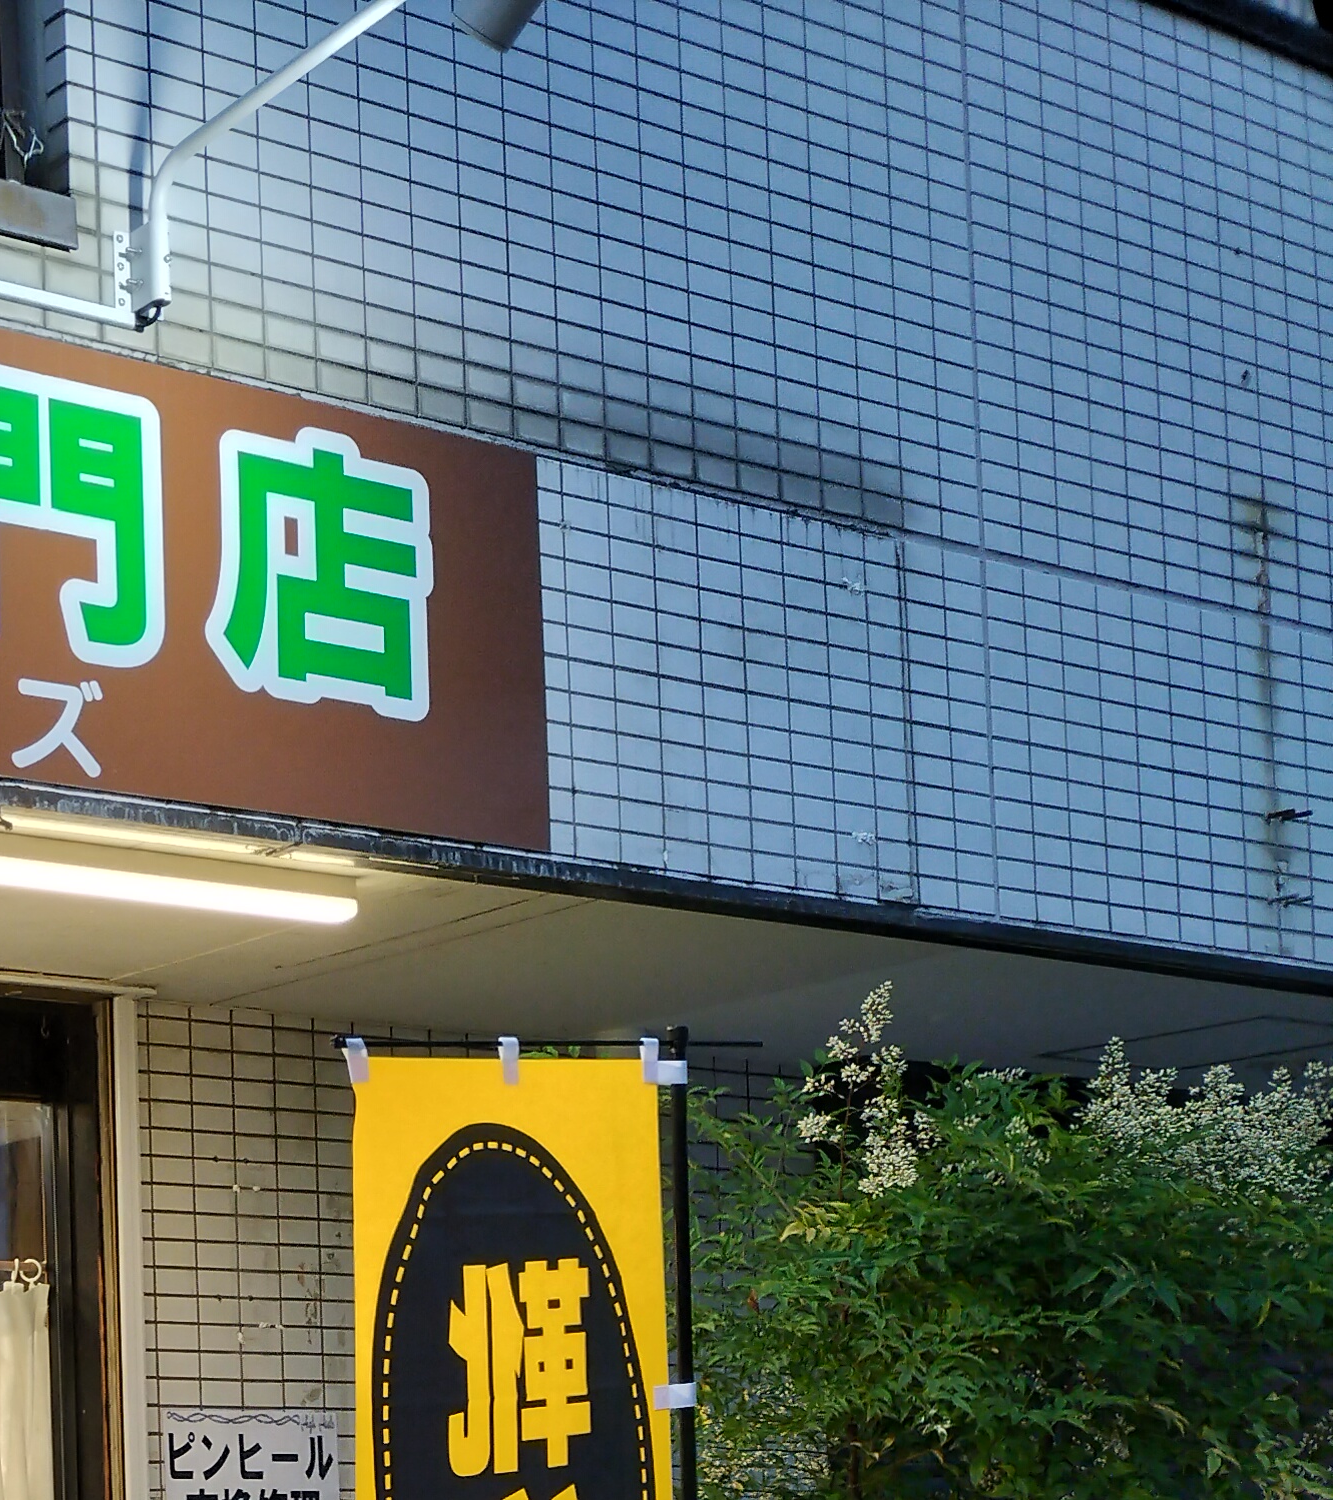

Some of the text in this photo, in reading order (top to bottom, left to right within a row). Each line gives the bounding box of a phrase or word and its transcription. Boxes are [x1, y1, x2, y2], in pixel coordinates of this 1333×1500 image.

[167, 1431, 333, 1481] ピンヒール
